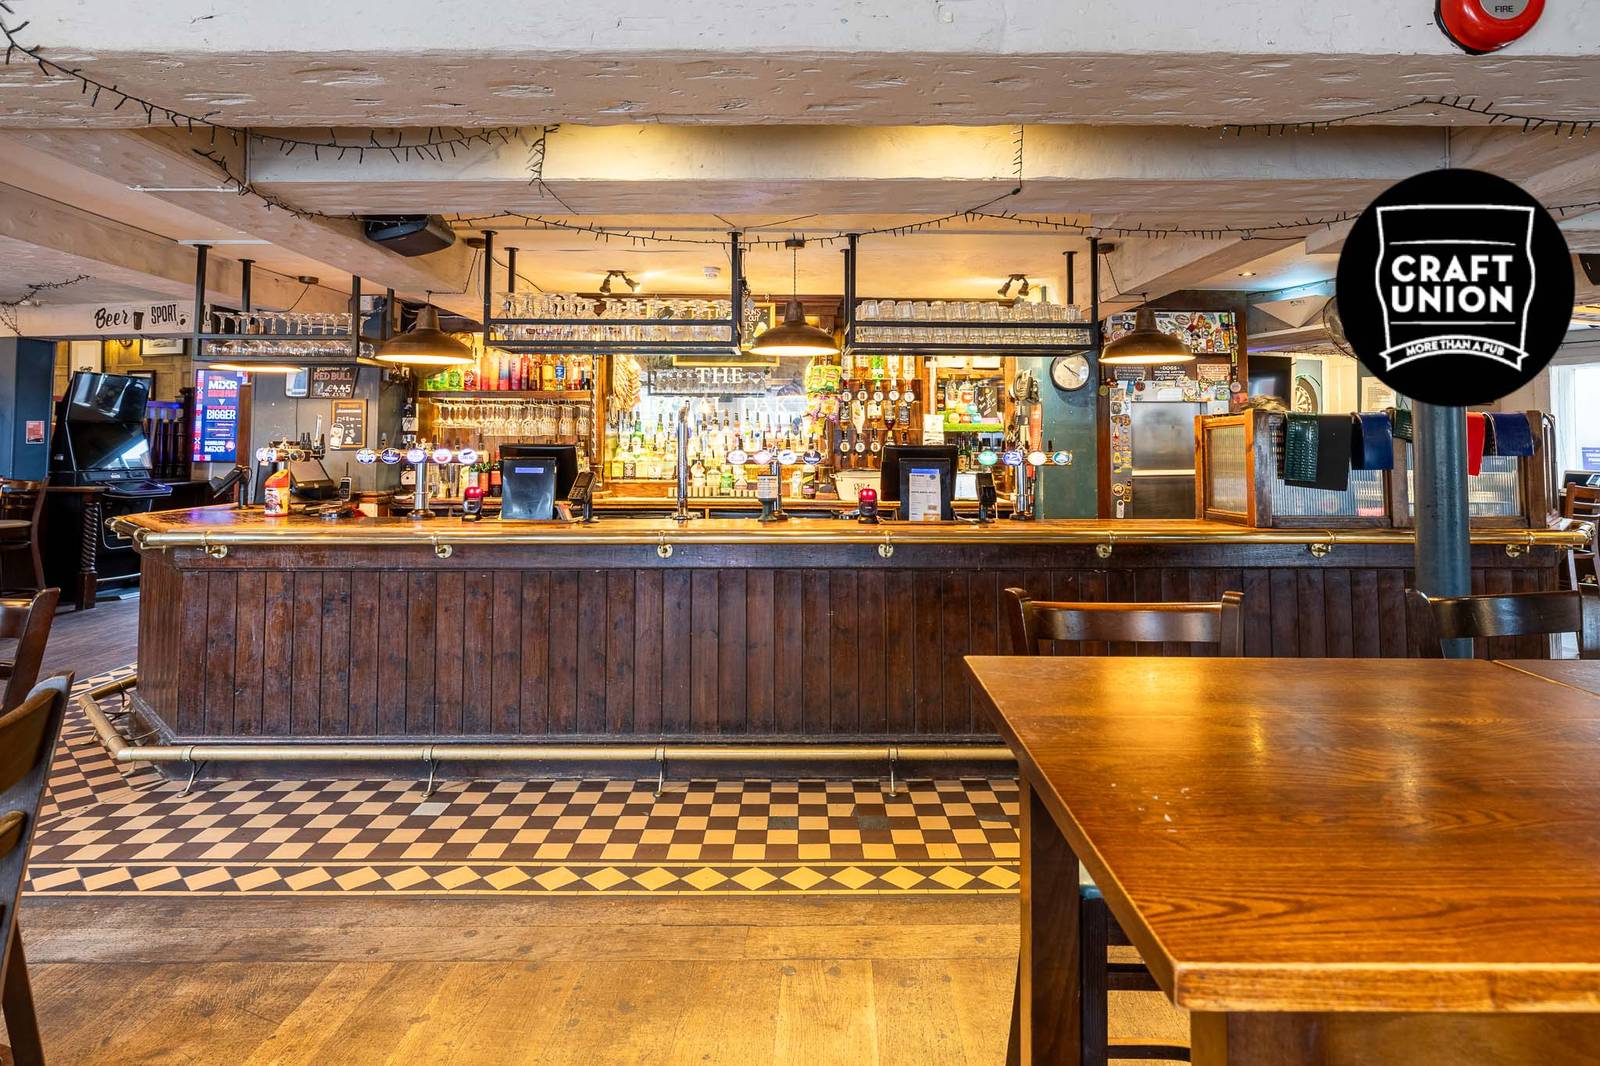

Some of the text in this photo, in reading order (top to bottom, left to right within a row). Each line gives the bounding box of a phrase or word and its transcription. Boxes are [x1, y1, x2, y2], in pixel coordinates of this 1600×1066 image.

[1494, 5, 1513, 13] FIRE
[94, 307, 129, 329] Beer
[151, 304, 177, 325] SPORT
[313, 372, 353, 381] RED BULL
[695, 367, 743, 384] THE
[208, 381, 238, 390] MIXR
[325, 384, 351, 393] £4.45
[206, 409, 236, 419] BIGGER
